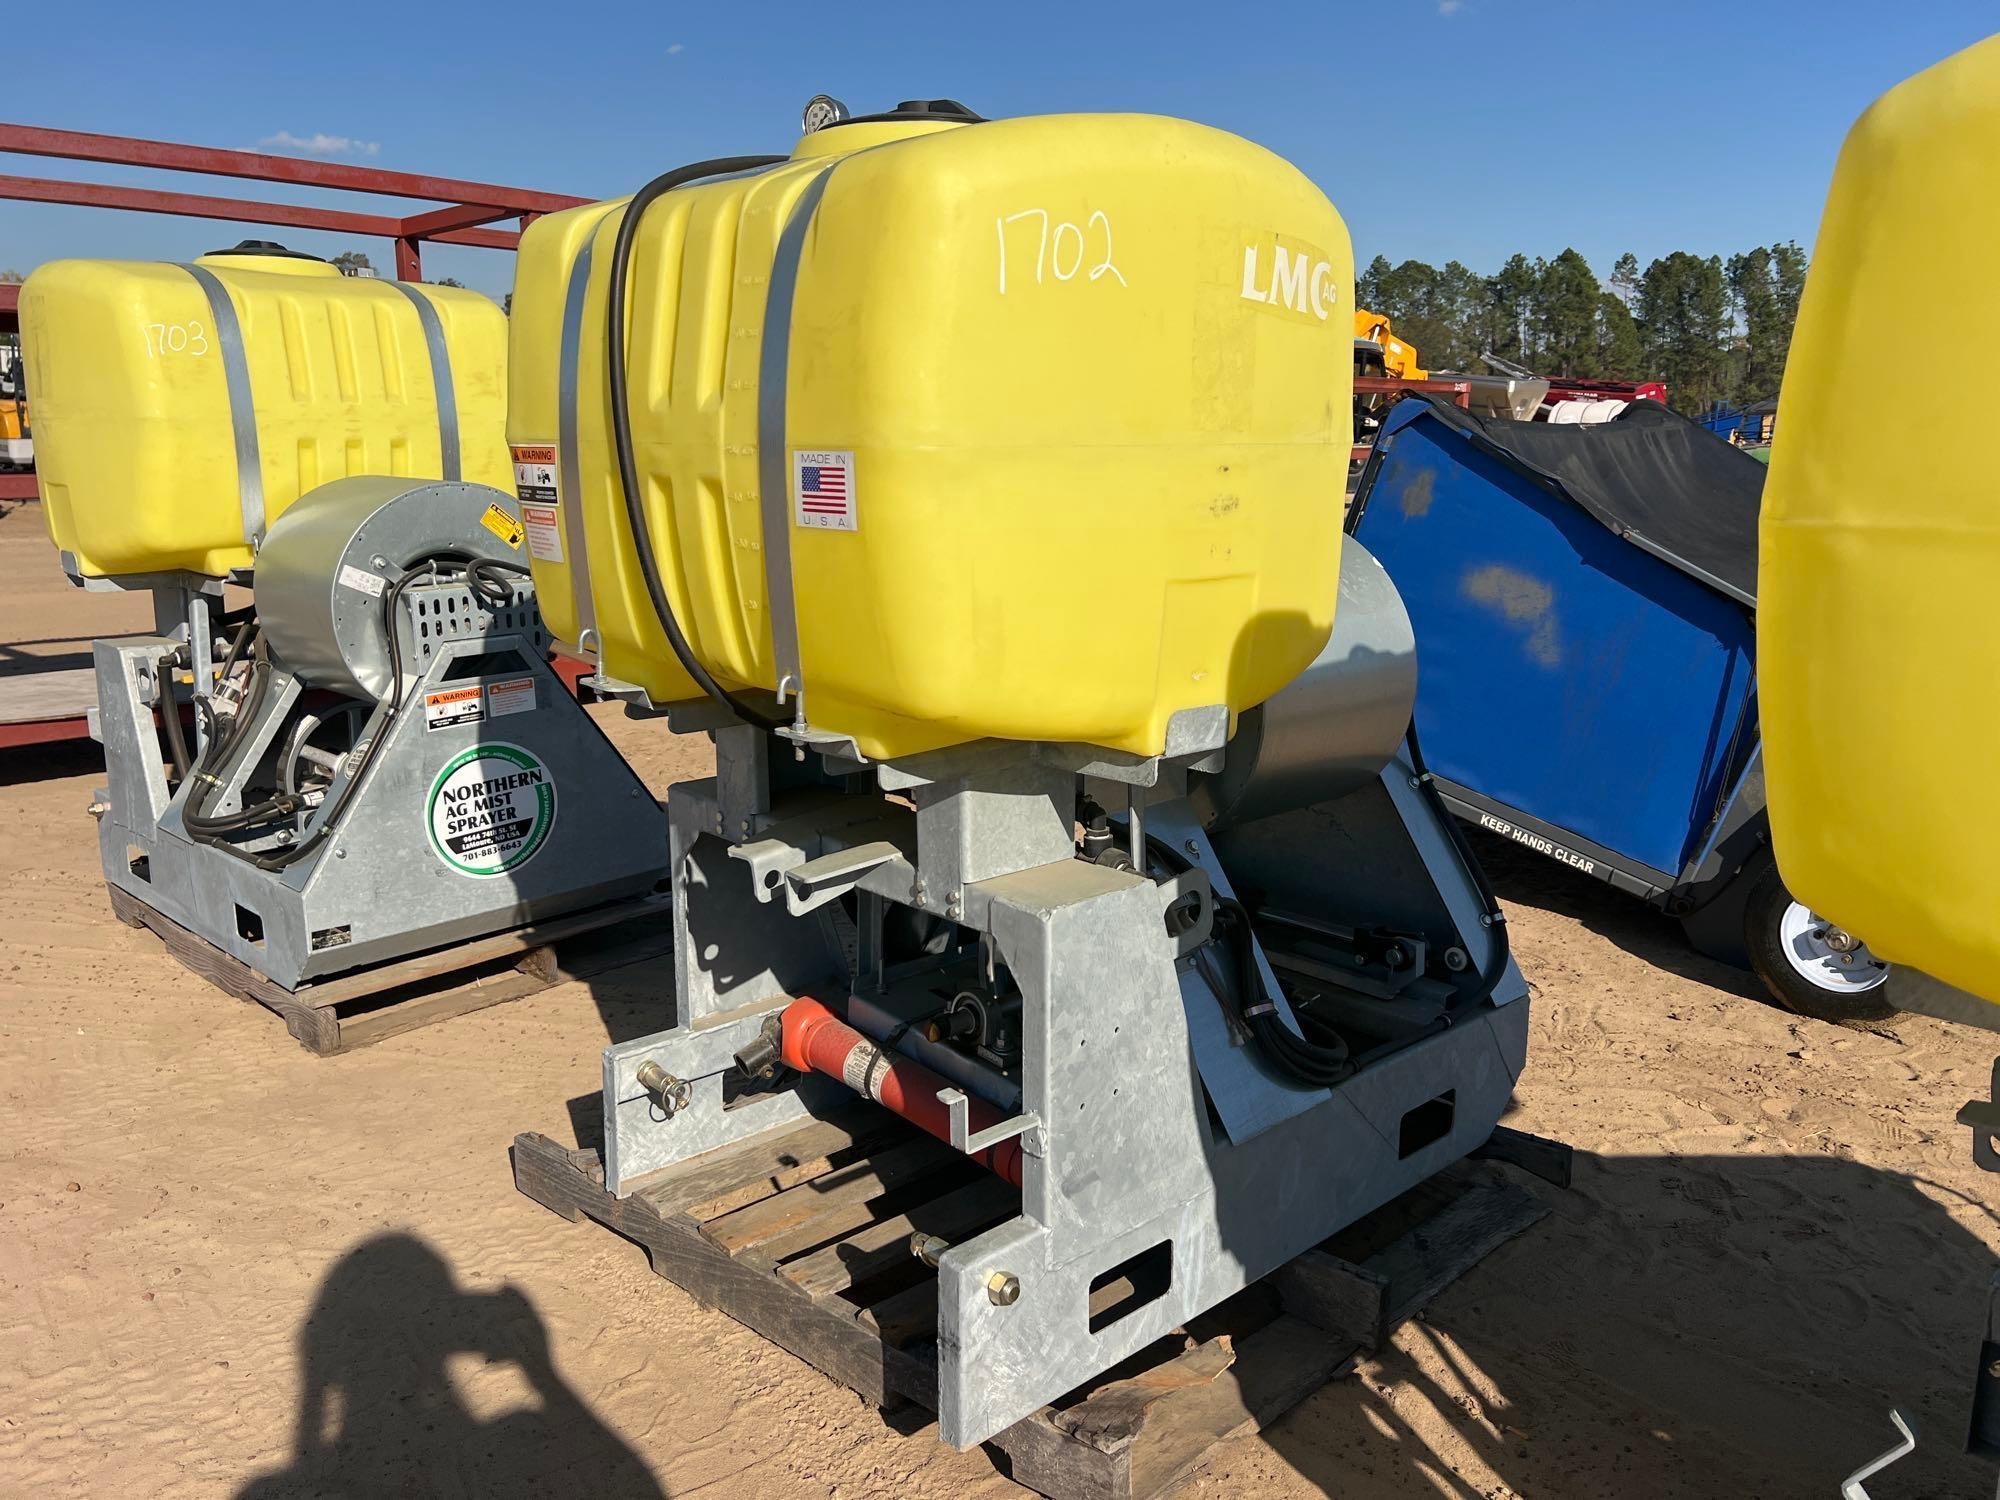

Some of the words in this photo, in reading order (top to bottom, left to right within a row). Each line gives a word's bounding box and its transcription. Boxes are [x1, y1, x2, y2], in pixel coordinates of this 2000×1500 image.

[997, 208, 1128, 294] 1702
[1241, 244, 1332, 321] LMC
[1322, 280, 1337, 303] AG
[143, 320, 208, 360] 1703
[520, 450, 552, 461] WARNING
[801, 454, 831, 464] MADE
[835, 454, 846, 465] IN
[442, 689, 479, 701] WARNING
[443, 769, 543, 805] NORTHERN
[446, 803, 468, 820] AG
[474, 792, 513, 813] MIST
[447, 806, 518, 835] SPRAYER
[506, 830, 520, 839] USA
[462, 840, 522, 862] 701-883-6643
[1480, 814, 1511, 835] KEEP
[1512, 829, 1553, 855] HANDS
[1554, 848, 1594, 874] CLEAR
